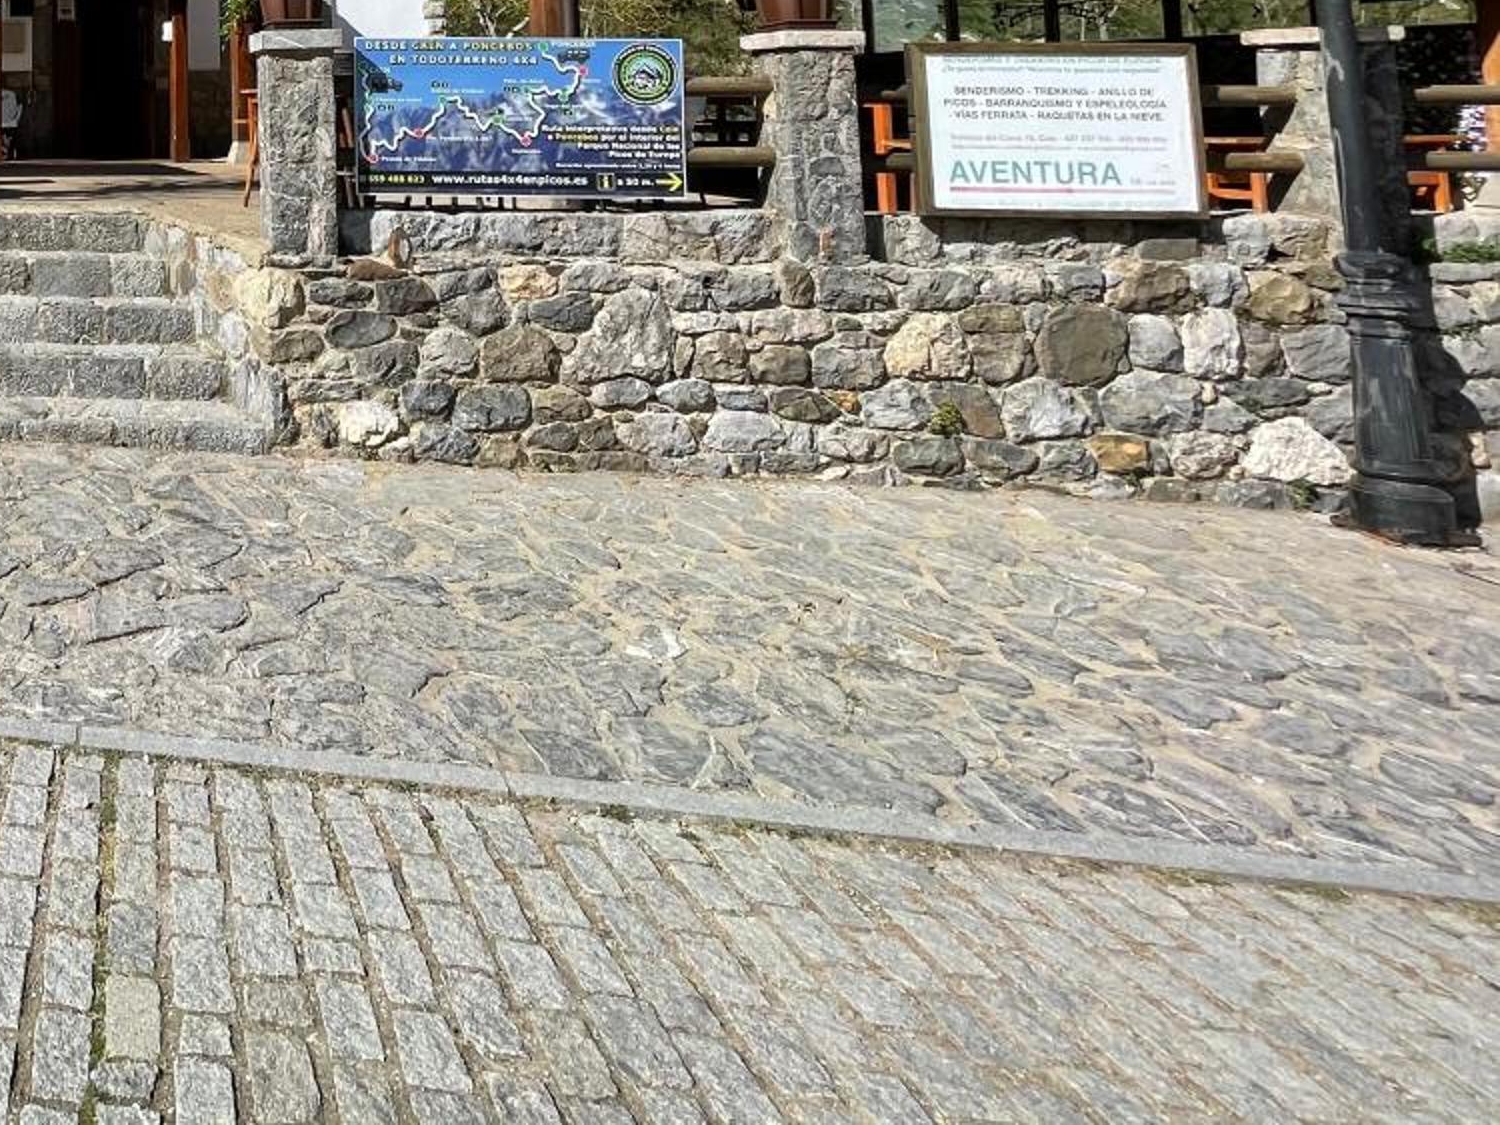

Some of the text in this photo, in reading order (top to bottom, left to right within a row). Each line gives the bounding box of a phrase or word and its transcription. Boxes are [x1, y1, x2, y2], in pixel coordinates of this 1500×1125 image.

[365, 42, 406, 51] DESDE
[389, 56, 405, 65] EN
[412, 56, 507, 65] TODOTERRENO
[954, 86, 1024, 96] SENDERISMO
[1034, 87, 1088, 96] TREKKING
[1098, 88, 1137, 96] ANILLO
[1139, 88, 1154, 96] DE
[943, 98, 977, 107] PICOS
[985, 99, 1073, 108] BARRANQUISMO
[1076, 100, 1083, 108] Y
[982, 111, 1028, 120] FERRATA
[1037, 111, 1094, 121] RAQUETAS
[1097, 112, 1111, 121] EN
[1114, 112, 1127, 121] LA
[950, 160, 1122, 185] AVENTURA
[431, 174, 588, 187] www.rutas4x4enpicos.es
